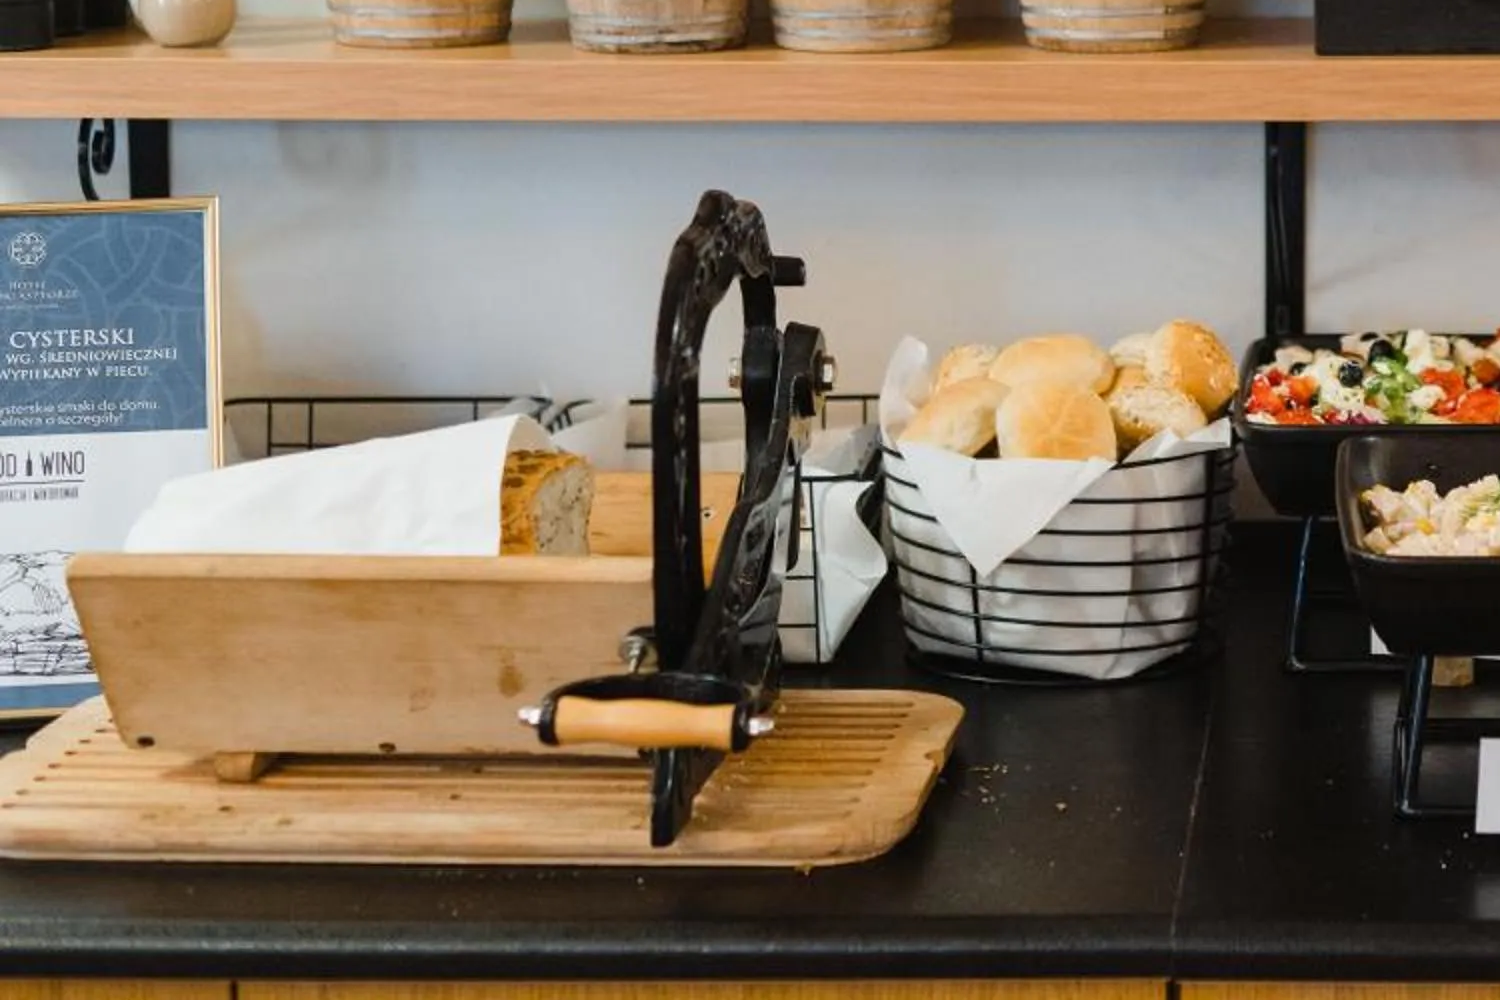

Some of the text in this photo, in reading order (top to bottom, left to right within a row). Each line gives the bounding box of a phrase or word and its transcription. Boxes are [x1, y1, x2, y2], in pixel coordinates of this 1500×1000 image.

[9, 328, 135, 349] CYSTERSKI
[5, 352, 35, 366] WG.
[87, 367, 99, 378] W
[41, 450, 85, 477] WINO
